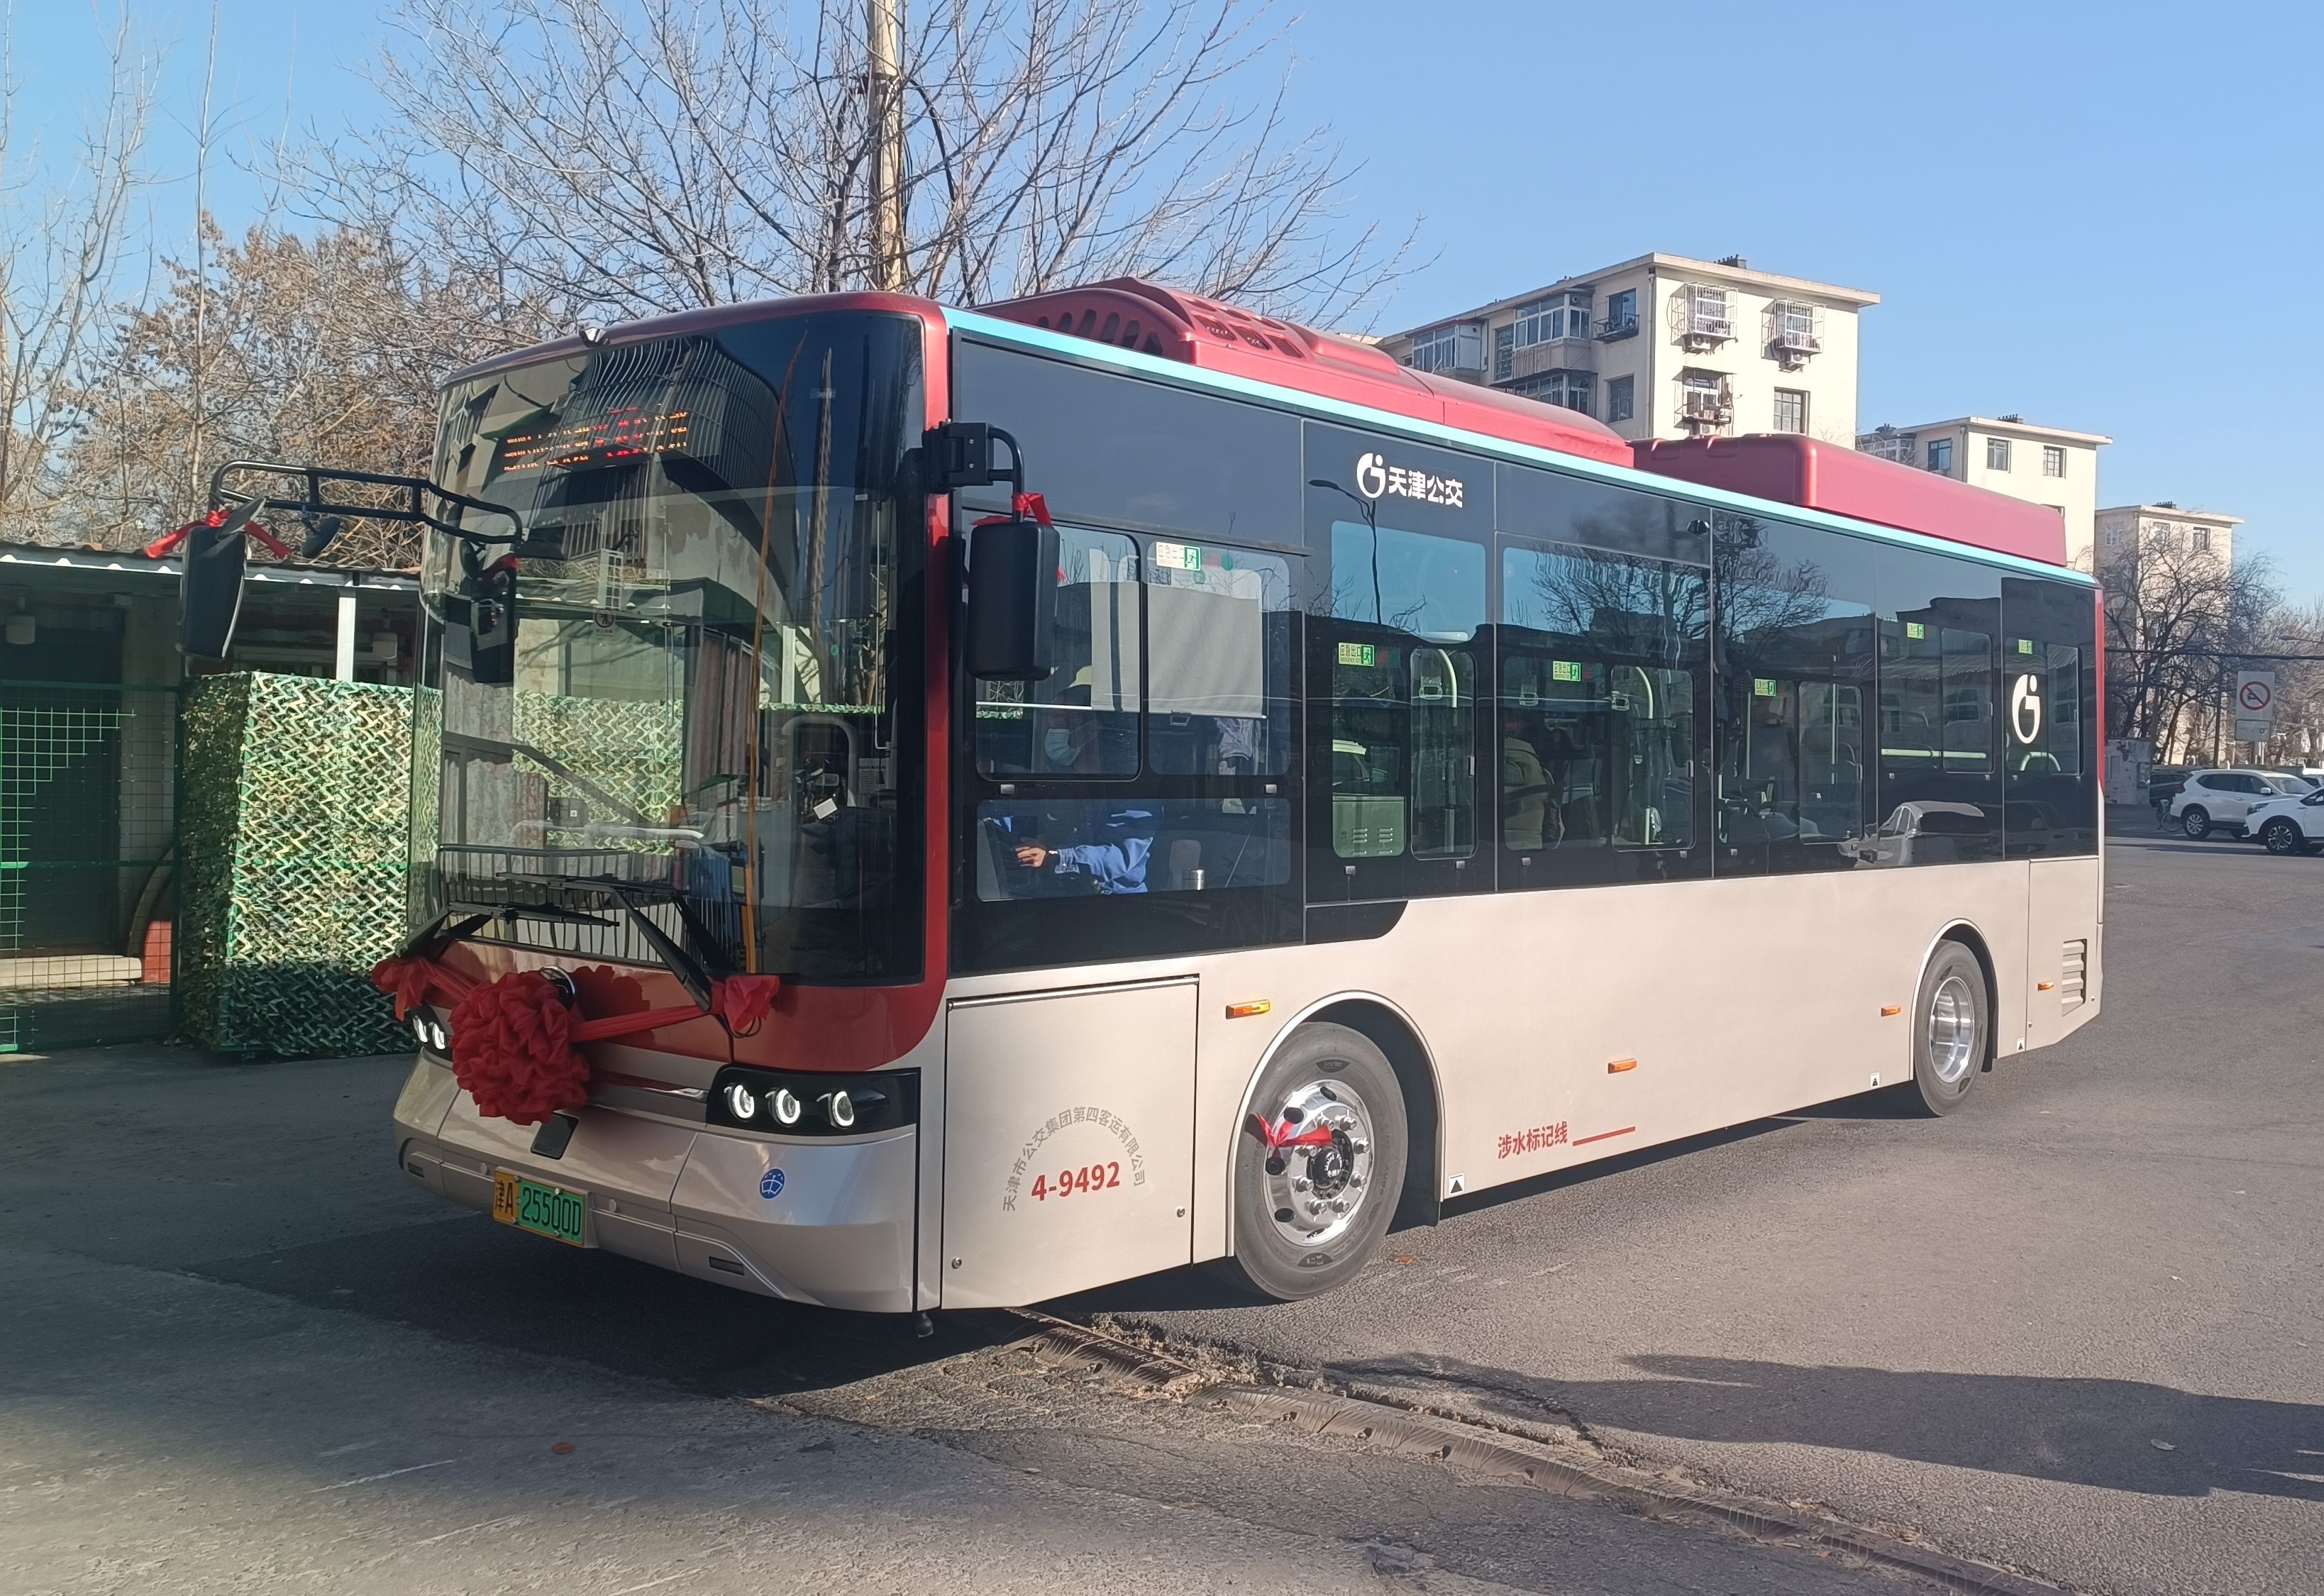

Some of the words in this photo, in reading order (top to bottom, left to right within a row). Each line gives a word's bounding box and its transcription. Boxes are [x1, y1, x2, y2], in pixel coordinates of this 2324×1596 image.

[1388, 466, 1463, 508] 天津公交
[1002, 1106, 1146, 1212] 天津市公交集团第四客运有限公司
[1498, 1121, 1568, 1159] 涉水标记线
[1031, 1161, 1120, 1202] 4-9492
[521, 1186, 582, 1236] 25500D
